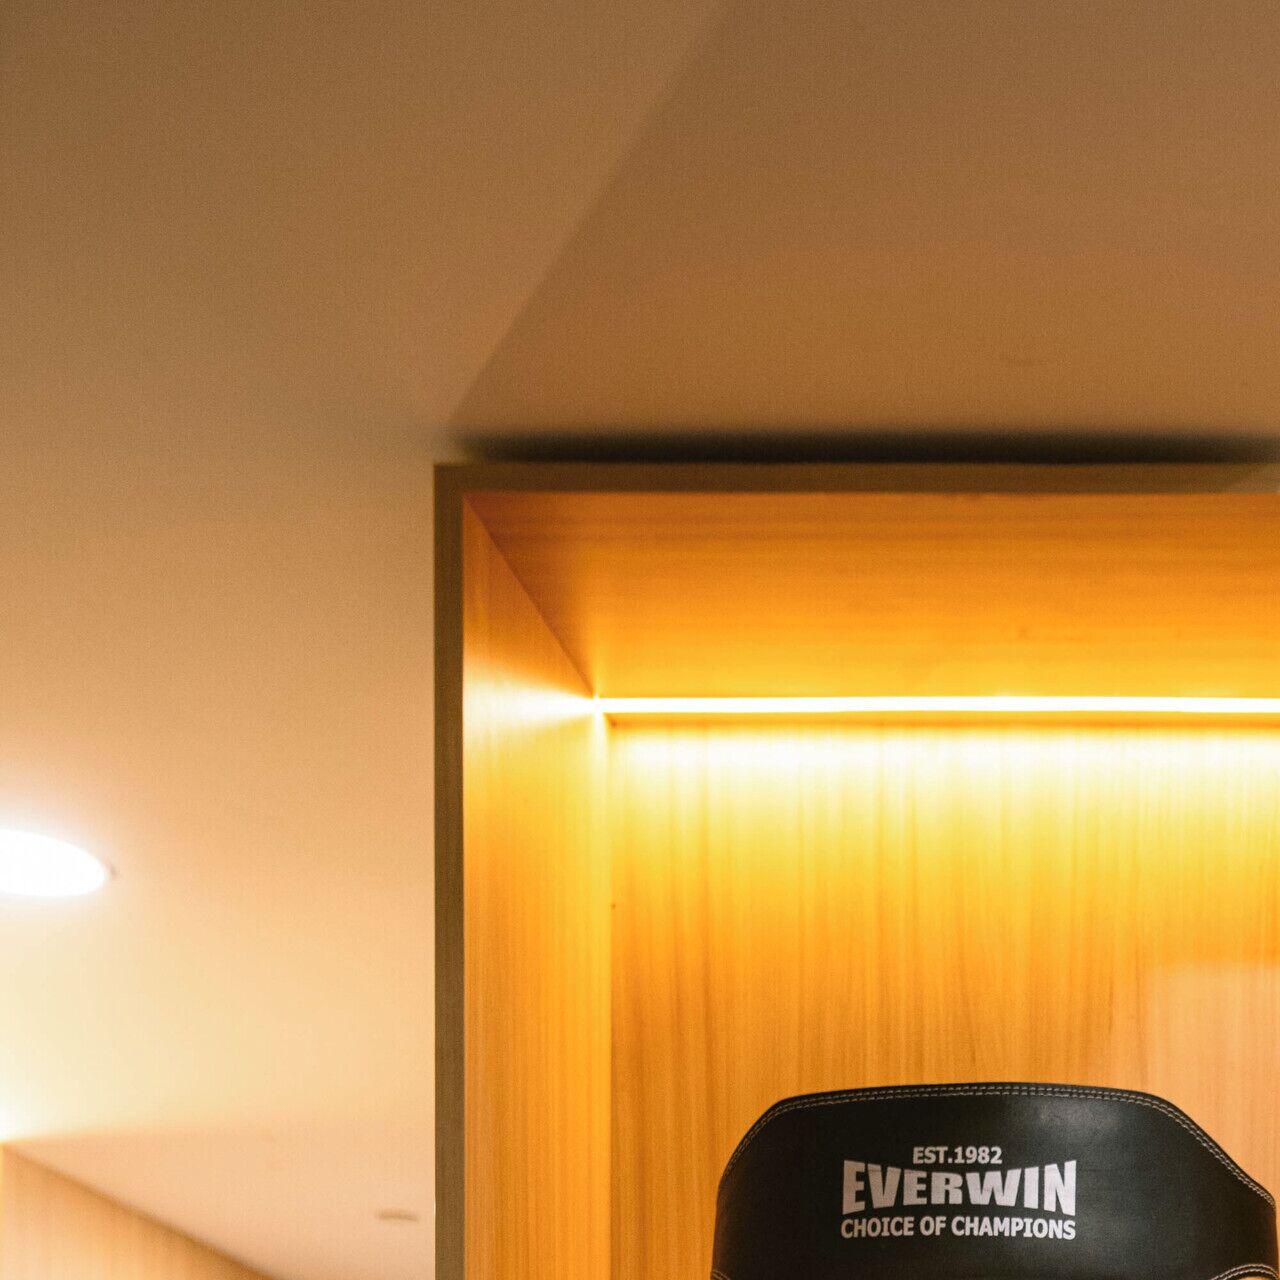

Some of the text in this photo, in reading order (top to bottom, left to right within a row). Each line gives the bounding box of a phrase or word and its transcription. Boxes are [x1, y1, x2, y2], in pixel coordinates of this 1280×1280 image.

[912, 1146, 1003, 1164] EST.1982
[842, 1159, 1077, 1216] EVERWIN
[840, 1216, 1077, 1240] CHOICE OF CHAMPIONS
